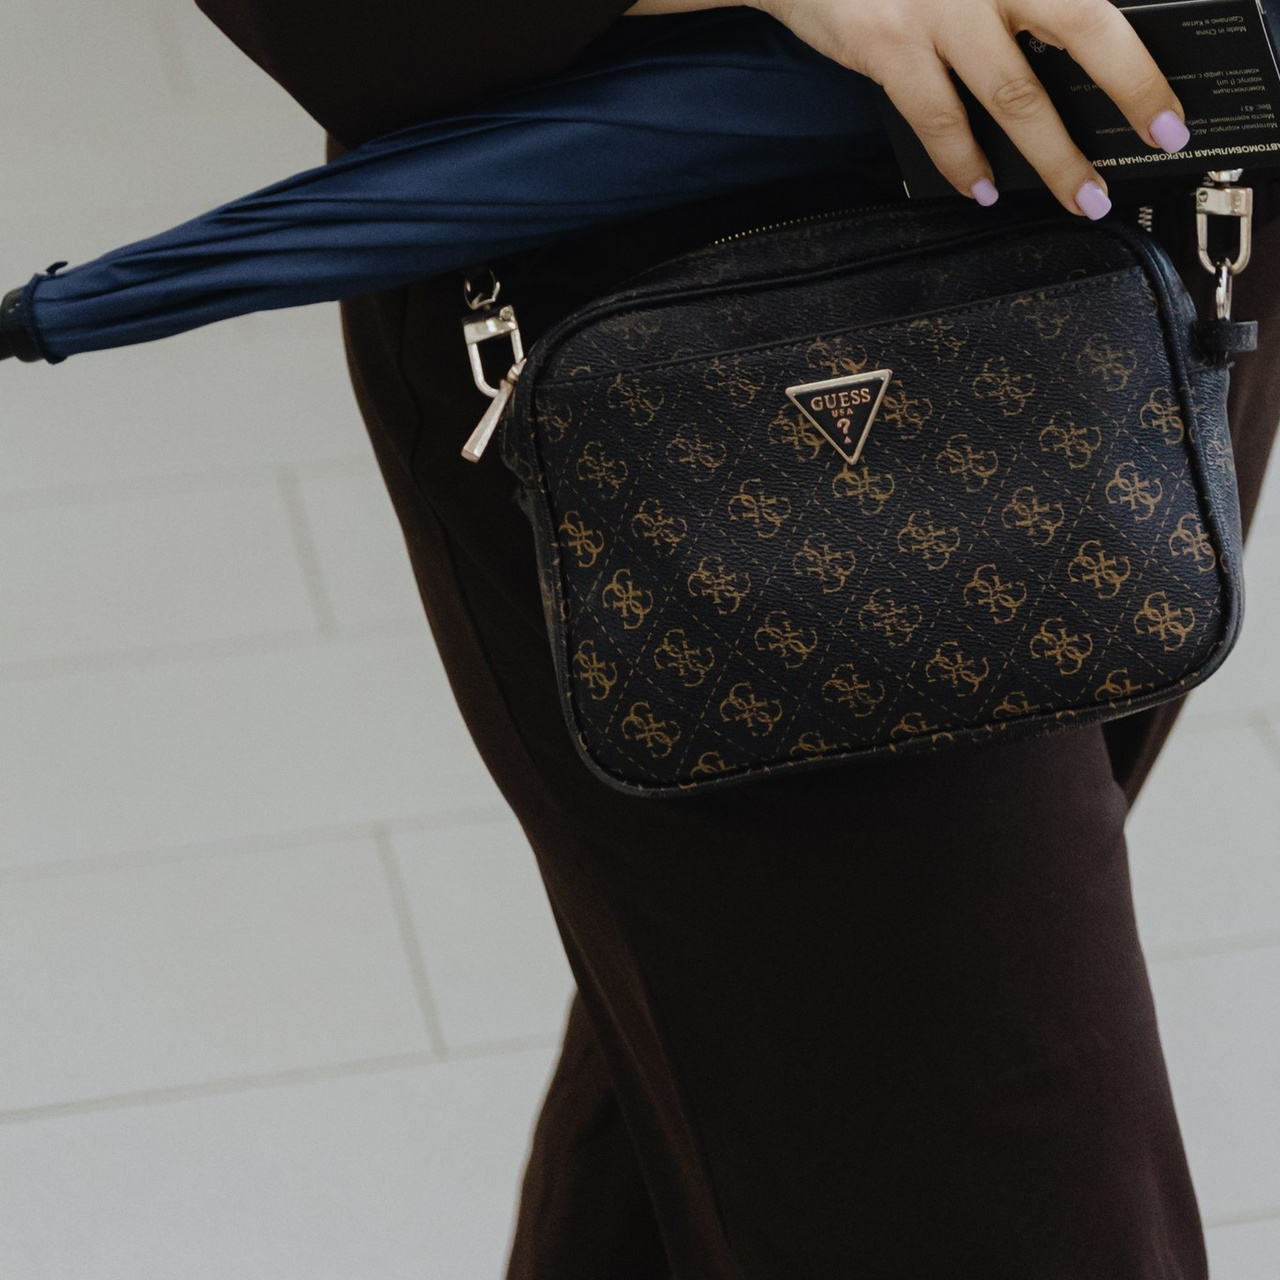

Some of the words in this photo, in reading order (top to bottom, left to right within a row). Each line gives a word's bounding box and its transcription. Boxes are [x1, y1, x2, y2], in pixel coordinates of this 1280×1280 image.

[1182, 20, 1203, 28] Китае
[1211, 16, 1243, 24] Сделано
[1196, 28, 1216, 36] China
[1226, 68, 1259, 76] комплект
[1237, 76, 1262, 84] корпус
[1242, 122, 1277, 130] Материал
[1119, 151, 1192, 164] ПАРКОВОЧНАЯ
[1091, 158, 1116, 167] ВИЗИ
[811, 388, 871, 411] GUESS
[832, 408, 853, 418] USA
